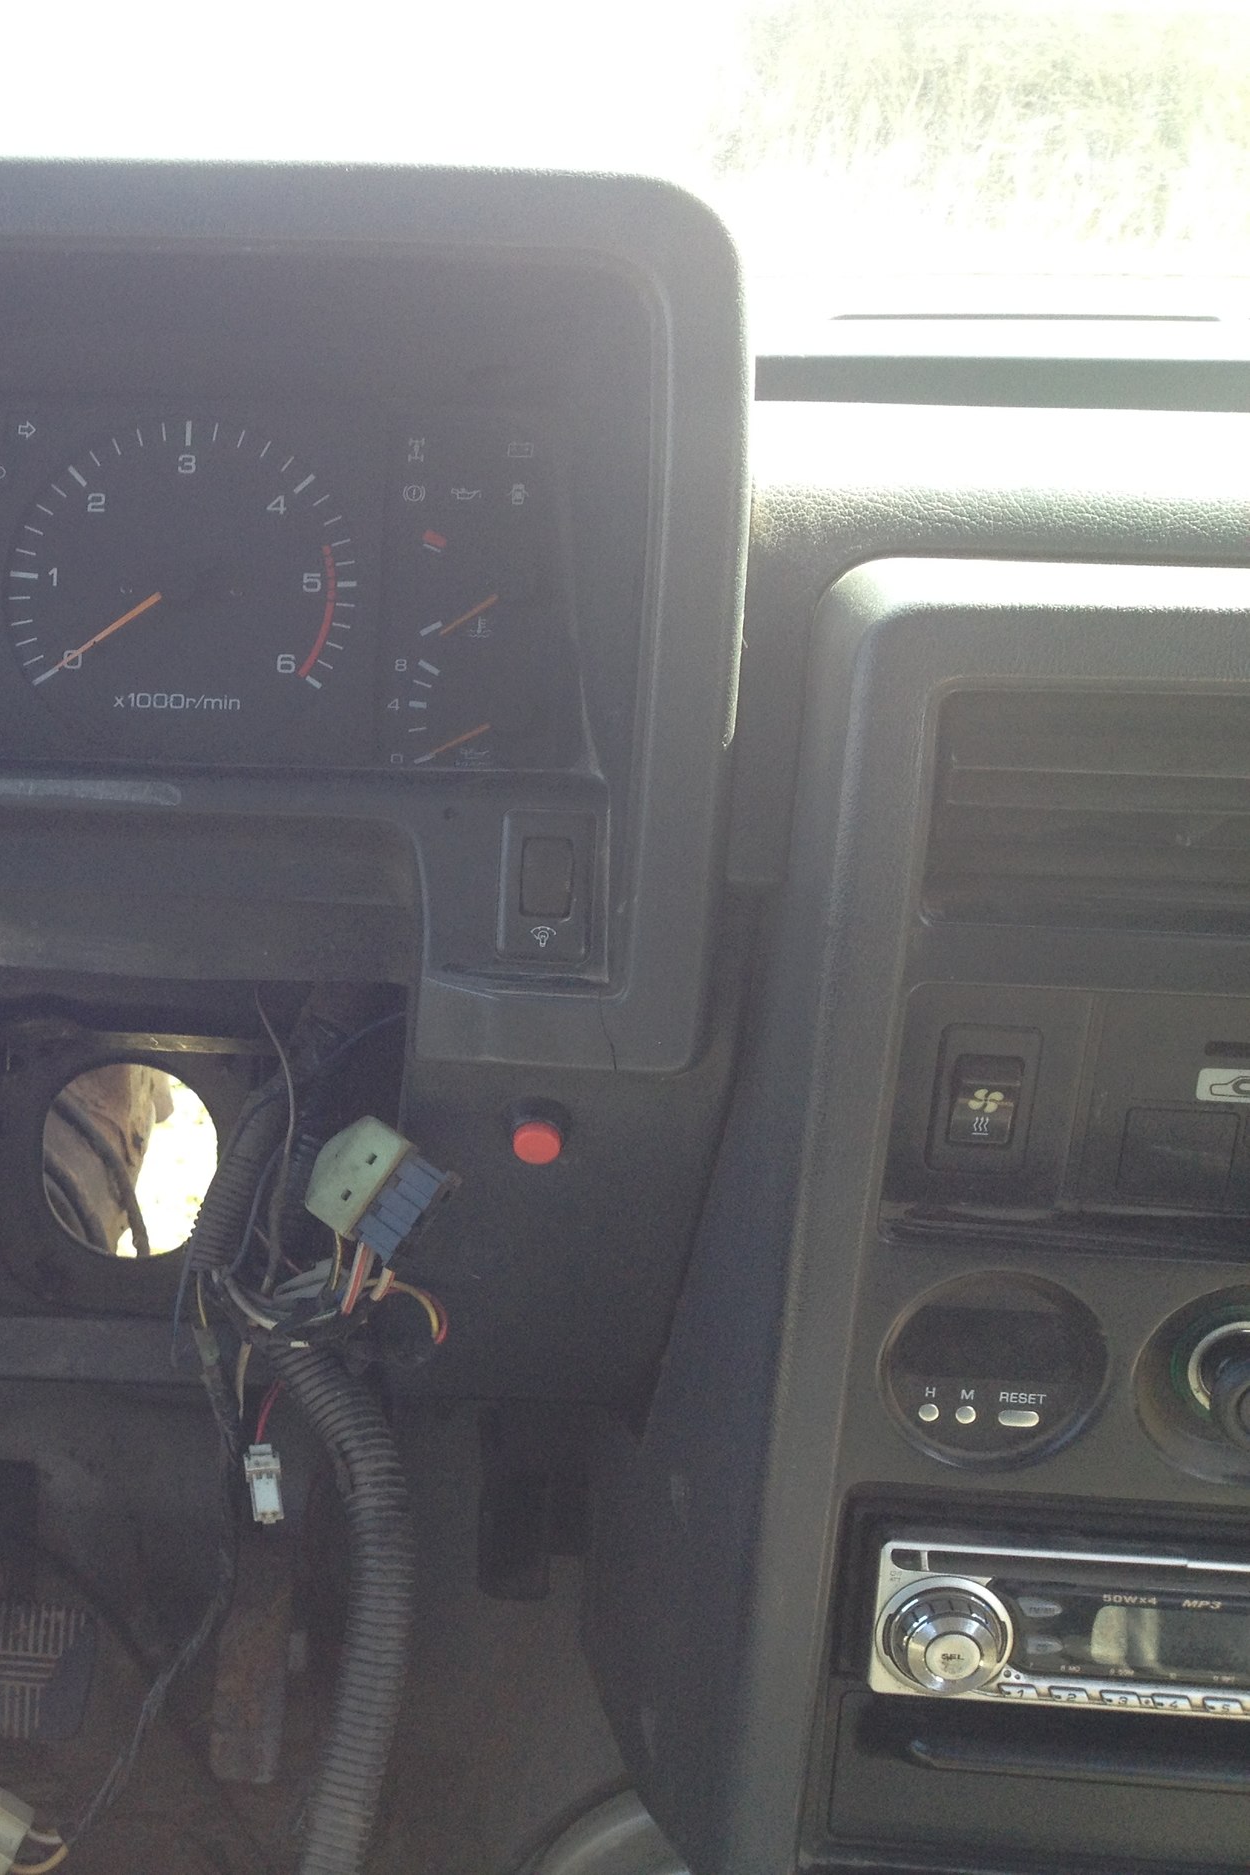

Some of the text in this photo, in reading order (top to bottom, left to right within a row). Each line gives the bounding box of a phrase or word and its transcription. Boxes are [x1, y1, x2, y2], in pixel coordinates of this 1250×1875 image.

[177, 454, 197, 475] 3
[87, 493, 106, 514] 2
[266, 496, 287, 515] 4
[48, 568, 59, 587] 1
[302, 573, 321, 593] 5
[63, 650, 83, 670] 0
[276, 654, 296, 674] 6
[394, 658, 408, 672] 8
[386, 698, 401, 711] 4
[924, 1386, 1047, 1405] H M RESET
[1181, 1598, 1223, 1611] MP3
